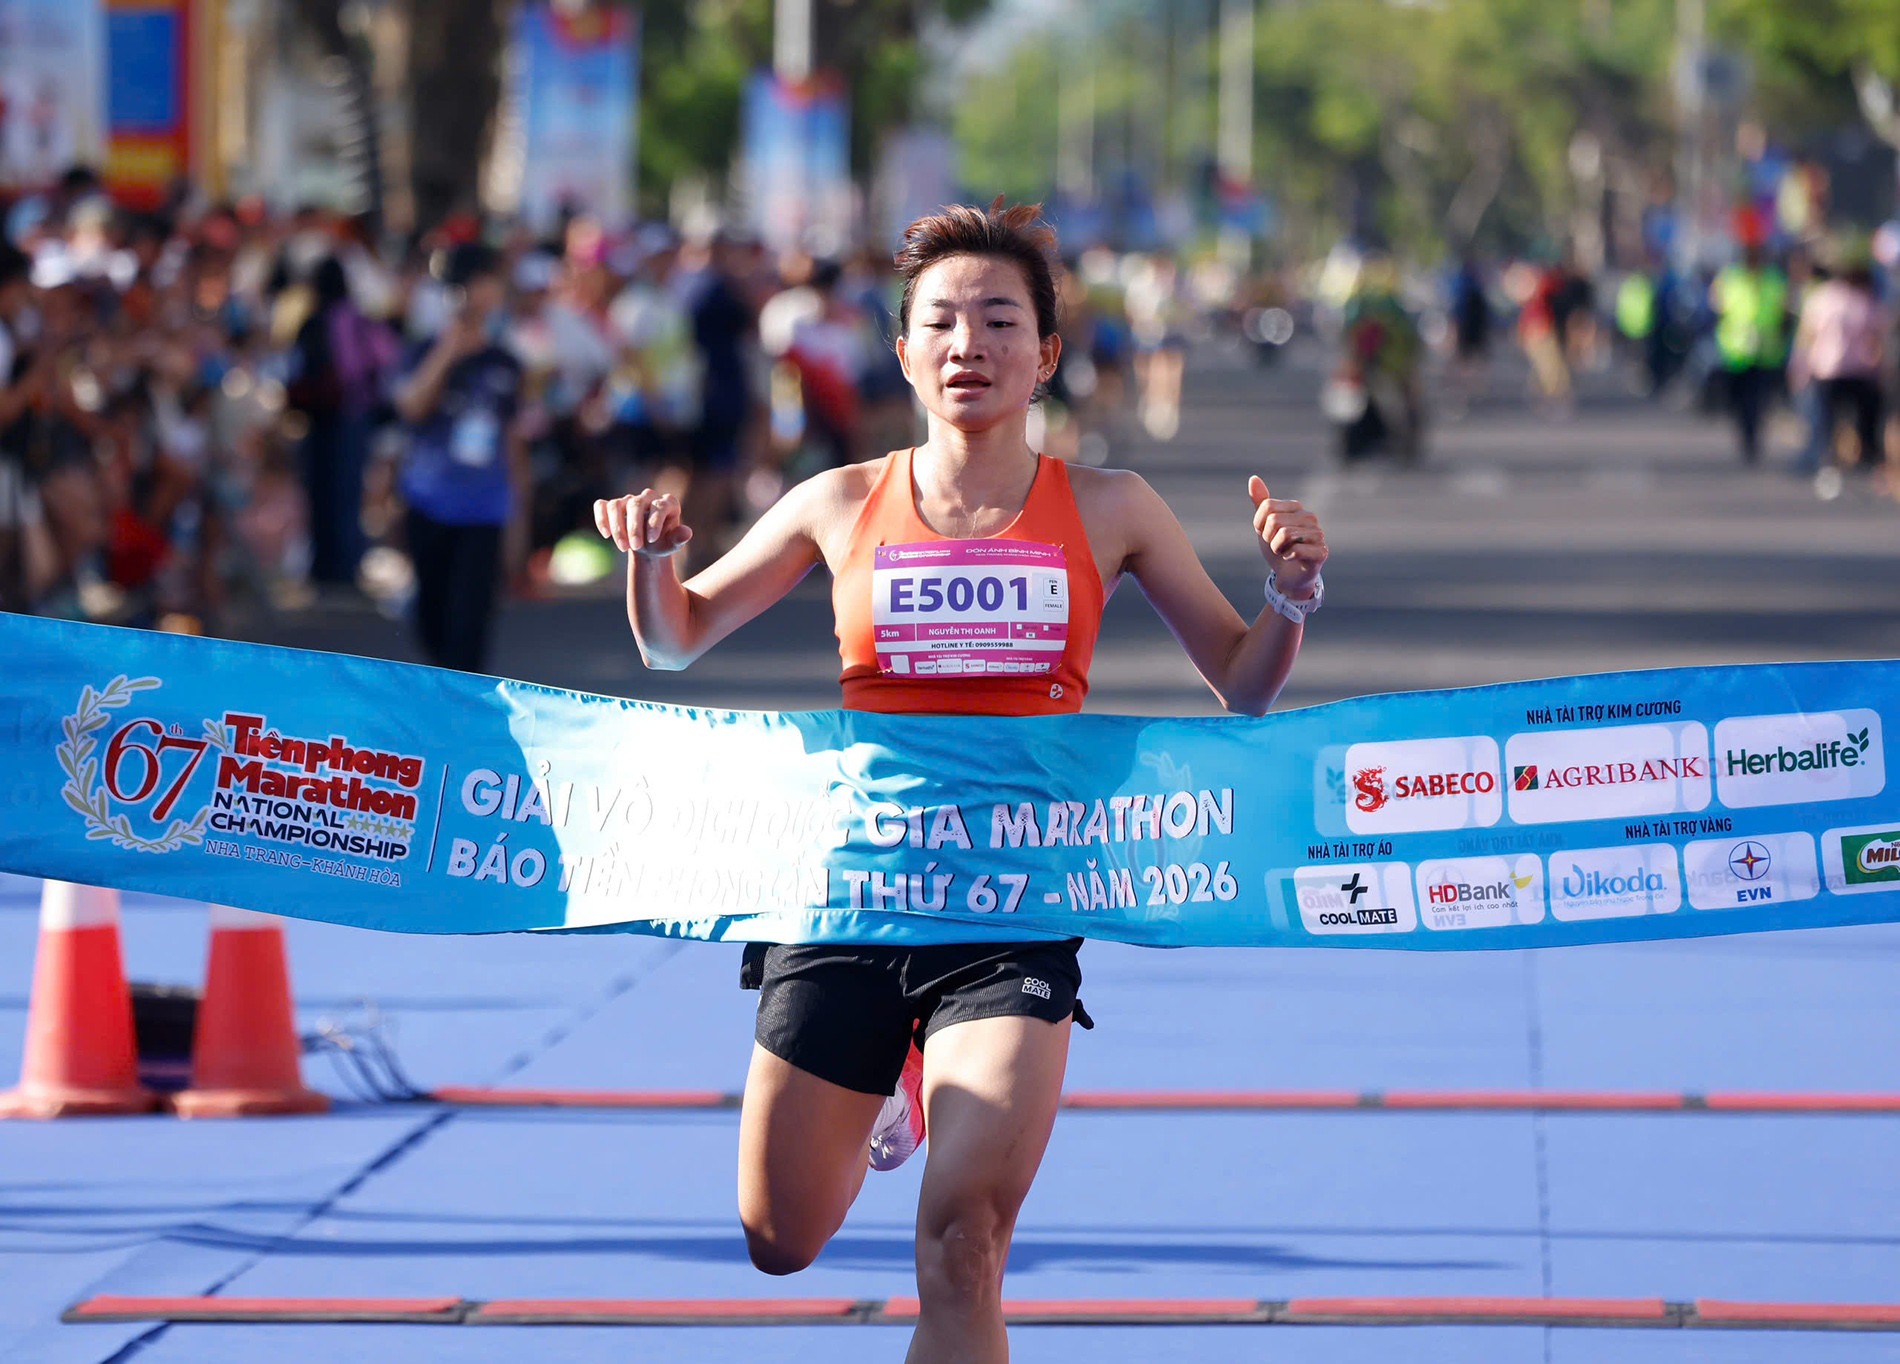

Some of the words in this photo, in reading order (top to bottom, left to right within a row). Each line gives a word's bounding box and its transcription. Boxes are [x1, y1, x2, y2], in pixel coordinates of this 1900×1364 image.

[890, 576, 1027, 613] E5001
[1050, 584, 1058, 595] E
[880, 629, 900, 638] 5km
[961, 628, 973, 636] THỊ
[973, 627, 997, 635] OANH
[1526, 706, 1552, 725] NHÀ
[1556, 705, 1574, 722] TÀI
[1578, 705, 1604, 723] TRỢ
[1607, 703, 1632, 719] KIM
[1635, 700, 1681, 717] CƯƠNG
[1727, 741, 1858, 776] Herbalife
[1395, 771, 1494, 798] SABECO
[1544, 756, 1703, 789] AGRIBANK
[217, 756, 416, 820] Marathon
[213, 791, 345, 829] NATIONAL
[460, 760, 573, 827] GIẢI
[864, 801, 973, 849] GIA
[990, 788, 1234, 848] MARATHON
[210, 813, 407, 860] CHAMPIONSHIP
[1625, 823, 1650, 839] NHÀ
[1652, 820, 1670, 837] TÀI
[1673, 819, 1697, 836] TRỢ
[1700, 817, 1732, 834] VÀNG
[1307, 842, 1331, 859] NHÀ
[1333, 841, 1349, 858] TÀI
[1352, 842, 1375, 859] TRỢ
[1377, 839, 1392, 856] ÁO
[1866, 847, 1900, 864] MIL
[206, 840, 241, 858] NHA
[368, 868, 401, 886] HÒA
[446, 832, 547, 888] BÁO
[842, 861, 954, 912] THỨ
[966, 873, 1029, 913] 67
[1066, 857, 1138, 912] NĂM
[1143, 861, 1239, 907] 2026
[1428, 881, 1511, 904] HDBank
[1736, 886, 1772, 902] EVN
[1022, 984, 1050, 999] MATE
[1024, 976, 1051, 991] COOL
